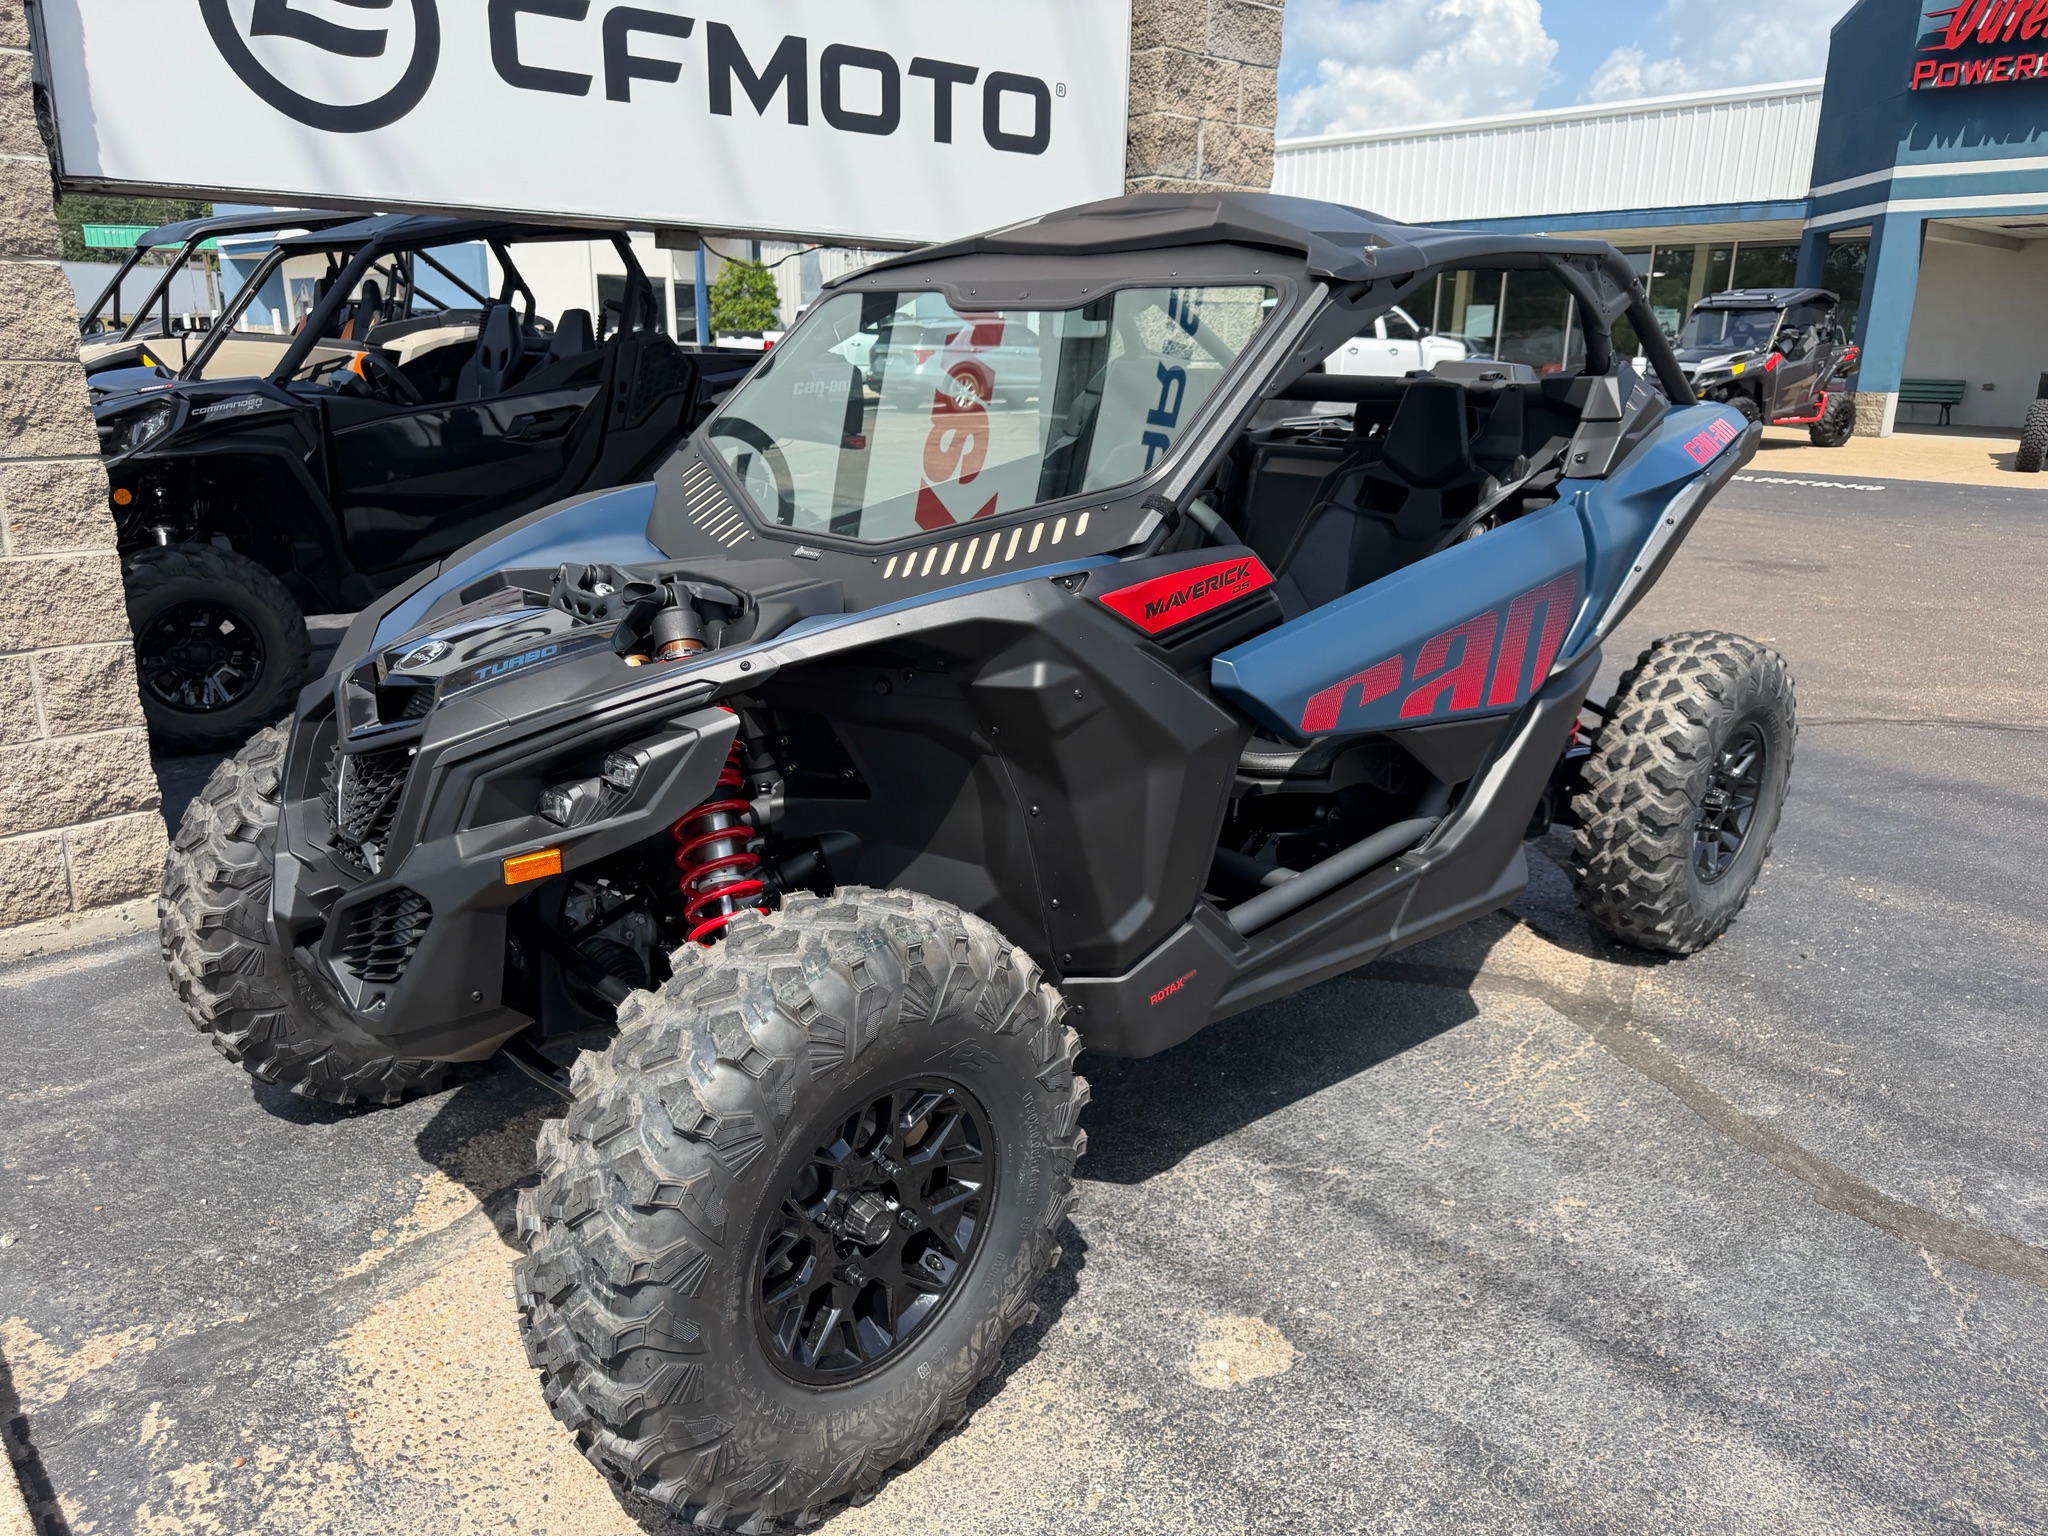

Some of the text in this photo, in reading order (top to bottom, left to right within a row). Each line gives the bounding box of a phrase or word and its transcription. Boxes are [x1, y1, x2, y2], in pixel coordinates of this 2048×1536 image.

[488, 0, 1051, 155] CFMOTO
[191, 397, 263, 416] COMMANDER
[246, 403, 263, 411] XT
[1144, 560, 1251, 620] MAVERICK
[1231, 580, 1251, 594] DS
[474, 644, 559, 681] TURBO
[1150, 978, 1184, 1006] ROTAX
